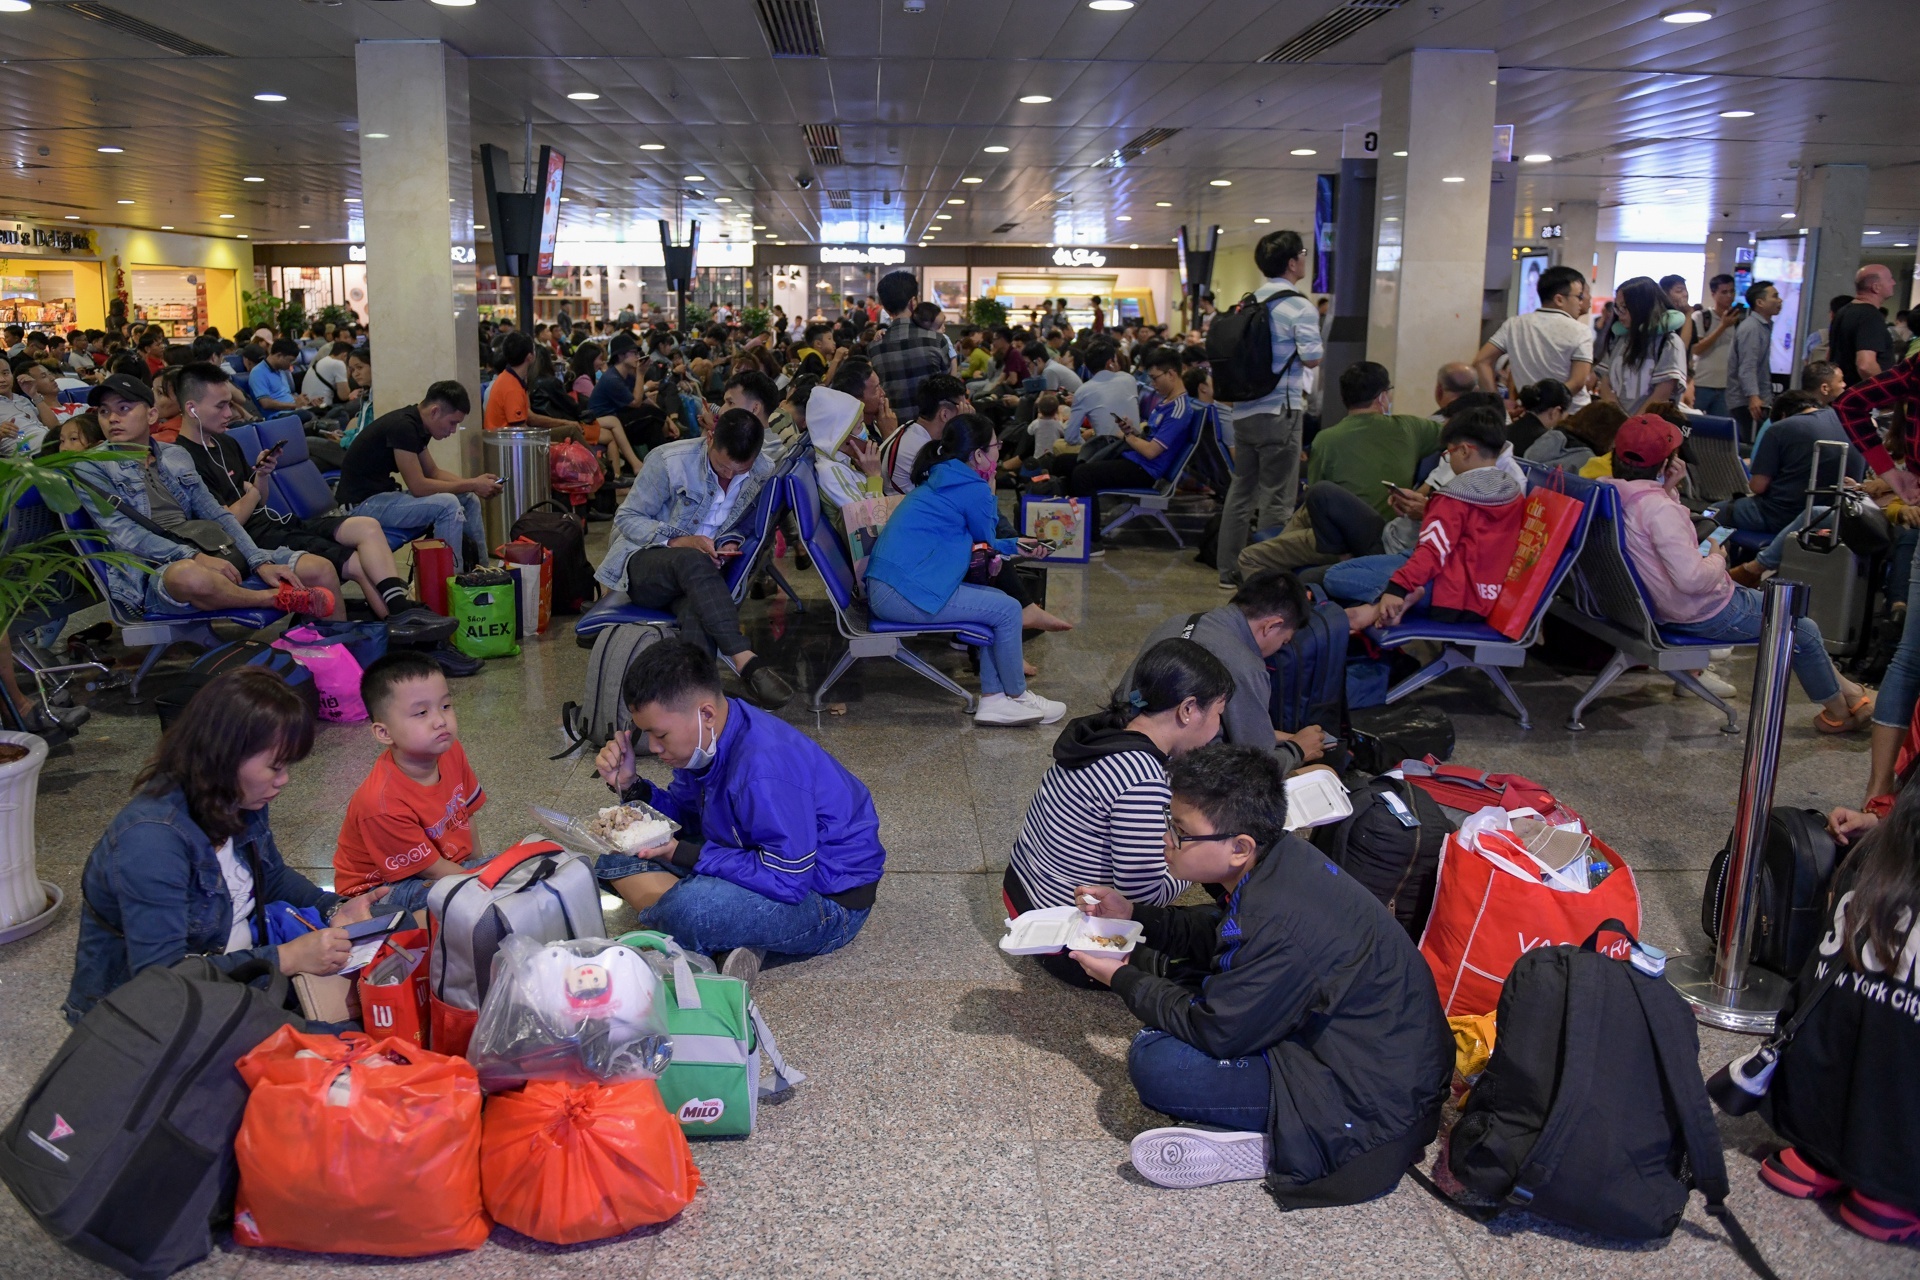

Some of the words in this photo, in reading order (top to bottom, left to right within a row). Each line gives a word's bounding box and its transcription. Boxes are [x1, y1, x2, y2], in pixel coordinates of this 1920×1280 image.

[466, 622, 511, 638] ALEX
[385, 842, 432, 870] COOL
[1852, 972, 1890, 1004] York
[372, 1004, 394, 1027] LU
[682, 1106, 719, 1118] MILO
